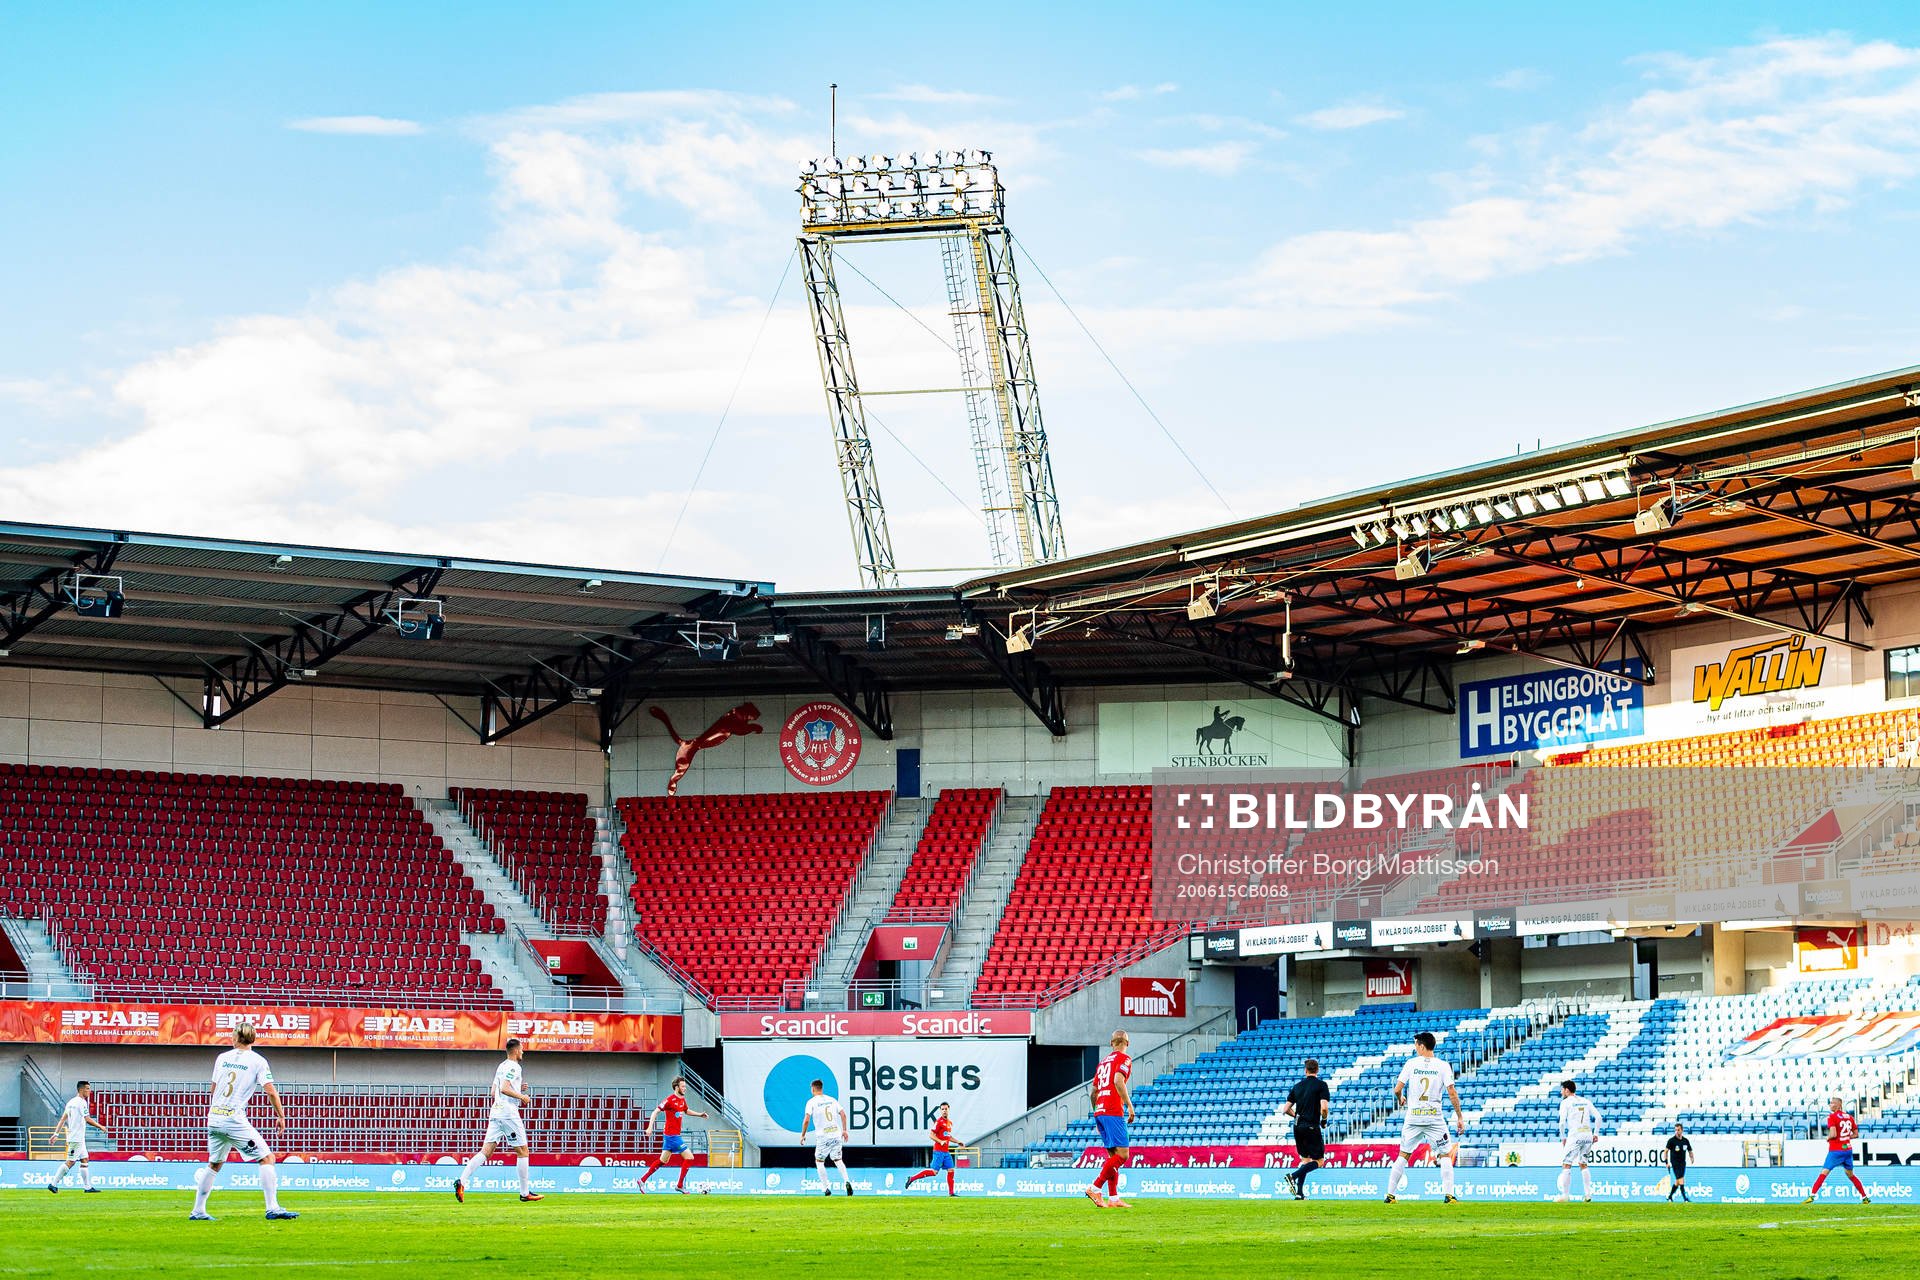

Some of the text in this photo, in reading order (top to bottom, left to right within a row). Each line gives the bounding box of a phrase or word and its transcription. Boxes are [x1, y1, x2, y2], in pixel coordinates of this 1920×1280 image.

[1693, 634, 1827, 711] WALLIN
[1758, 705, 1774, 716] och
[1504, 694, 1633, 744] BYGGPLÅT
[811, 742, 828, 753] HIF
[1386, 928, 1402, 936] KLAR
[1402, 927, 1413, 935] DIG
[1414, 925, 1422, 933] PÅ
[1424, 924, 1447, 933] JOBBET
[1245, 934, 1308, 947] VI KLAR DIG PÅ JOBBET
[1368, 977, 1401, 996] PUMA
[1124, 997, 1169, 1016] PUMA
[72, 1010, 148, 1026] PEAB
[227, 1013, 299, 1030] PEAB
[375, 1016, 444, 1032] PEAB
[761, 1014, 848, 1035] Scandic
[902, 1012, 992, 1034] Scandic
[519, 1019, 584, 1036] PEAB
[849, 1056, 981, 1091] Resurs
[1097, 1062, 1111, 1090] 39
[1413, 1068, 1438, 1076] Derome
[223, 1071, 236, 1097] 3
[1419, 1077, 1430, 1101] 2
[825, 1106, 833, 1122] 6
[849, 1096, 941, 1130] Bank
[1578, 1106, 1584, 1124] 7
[1587, 1147, 1667, 1167] asatorp.go
[91, 1176, 105, 1186] en
[109, 1173, 168, 1188] upplevelse
[281, 1175, 294, 1187] är
[295, 1177, 309, 1187] en
[312, 1175, 370, 1188] upplevelse
[473, 1178, 484, 1188] är
[486, 1179, 499, 1189] en
[659, 1179, 669, 1188] är
[1017, 1180, 1047, 1194] Städning
[1047, 1181, 1056, 1192] är
[1056, 1183, 1065, 1192] en
[1140, 1180, 1236, 1195] Städning är en upplevelse
[1311, 1181, 1320, 1195] är
[1321, 1184, 1332, 1195] en
[1333, 1181, 1378, 1197] upplevelse
[1465, 1182, 1474, 1195] är
[1476, 1184, 1488, 1195] en
[1490, 1181, 1538, 1197] upplevelse
[1632, 1182, 1642, 1196] är
[1821, 1184, 1833, 1198] är
[1835, 1187, 1849, 1198] en
